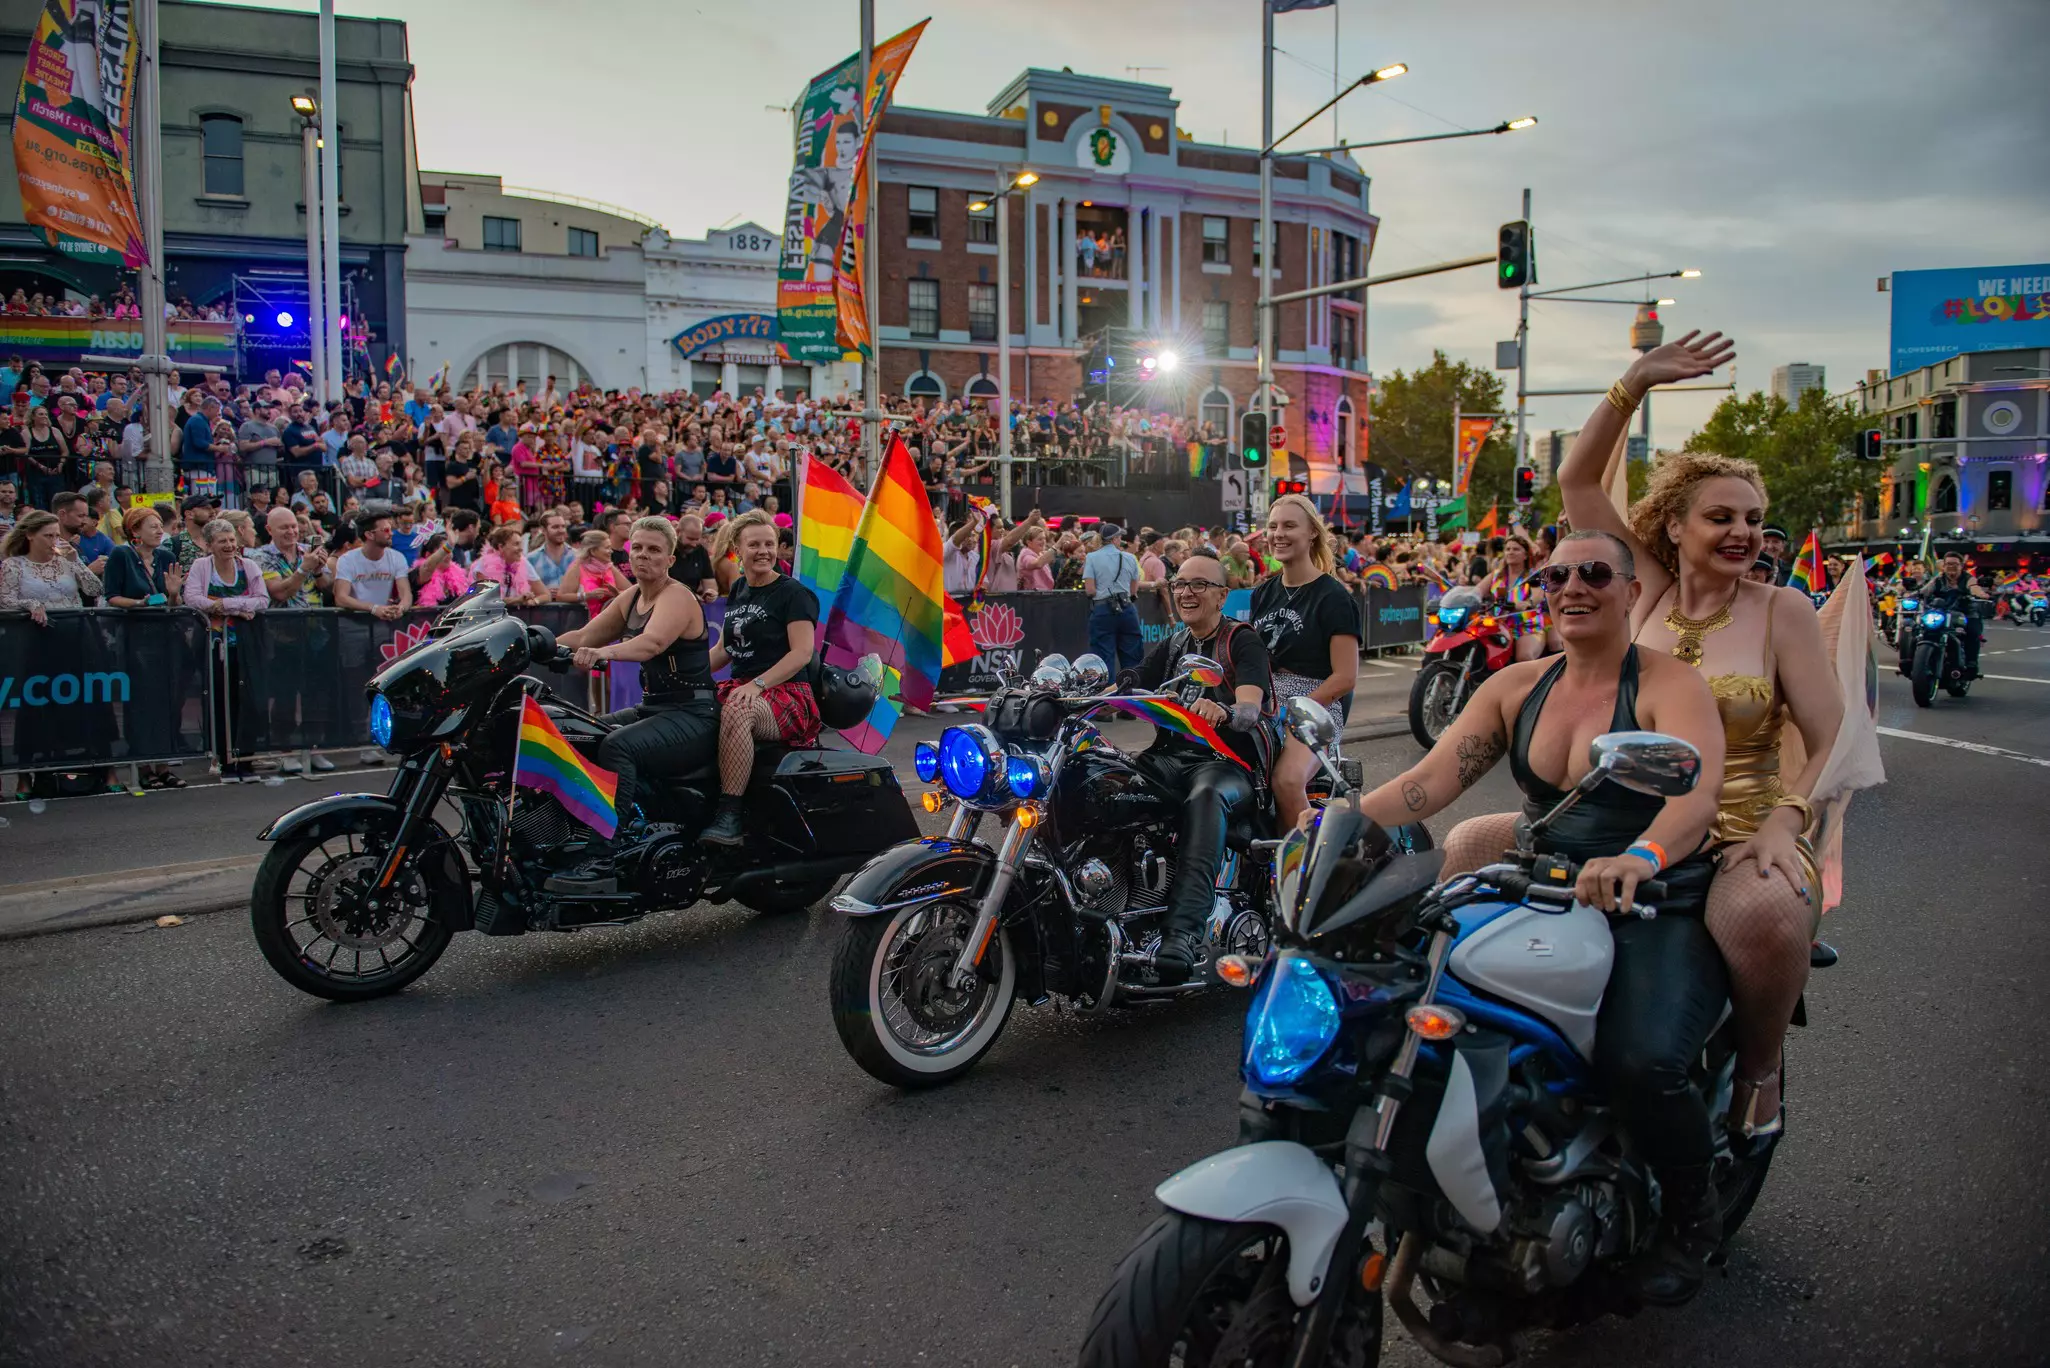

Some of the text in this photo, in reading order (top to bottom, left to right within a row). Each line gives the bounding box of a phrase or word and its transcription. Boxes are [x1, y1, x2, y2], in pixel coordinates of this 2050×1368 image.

[75, 241, 97, 253] SYDNEY
[729, 233, 772, 252] 1887
[1978, 278, 2006, 296] WE
[678, 315, 771, 353] BODY 777
[723, 354, 780, 365] RESTAURANT
[1379, 605, 1419, 626] sydney.com
[970, 650, 1023, 673] NSW
